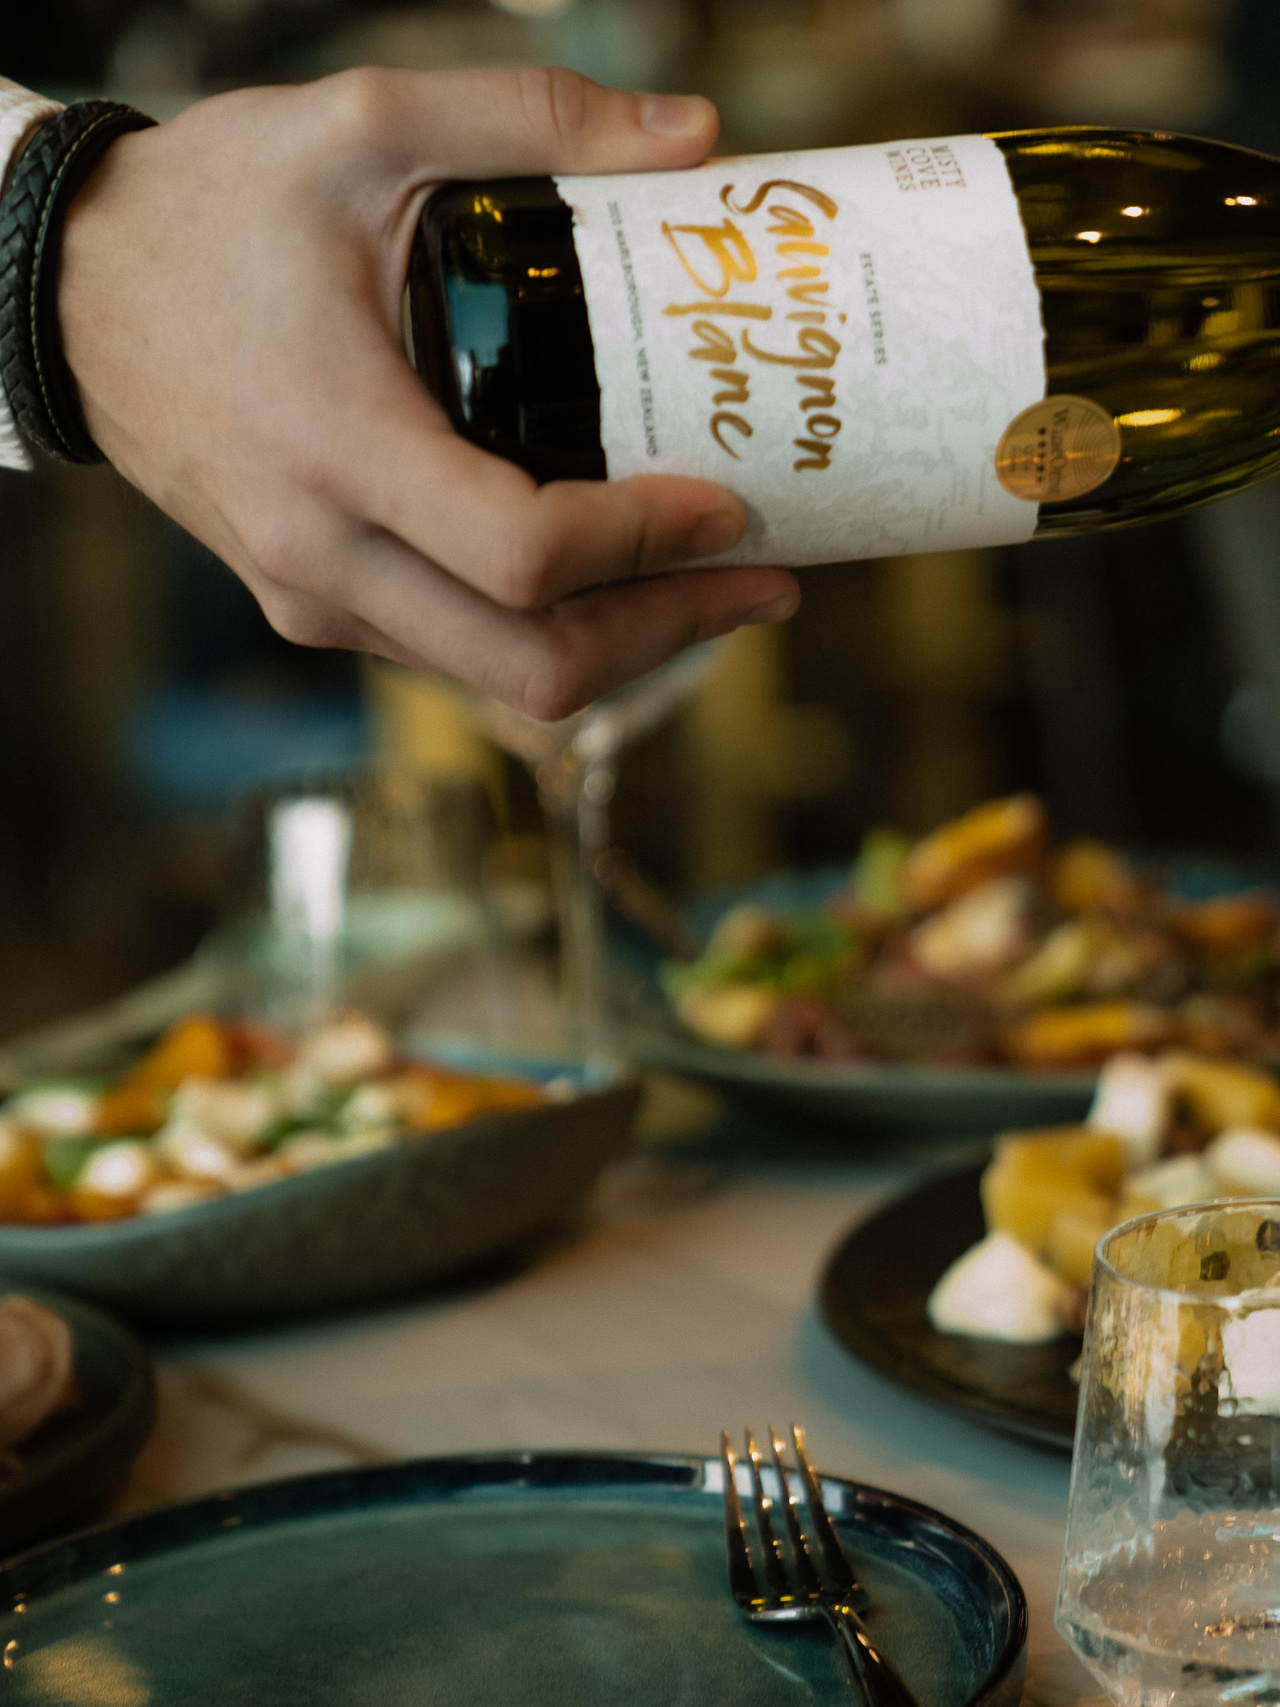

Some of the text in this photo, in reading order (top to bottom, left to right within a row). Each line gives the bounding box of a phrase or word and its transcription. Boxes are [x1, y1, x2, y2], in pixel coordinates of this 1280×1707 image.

[885, 149, 917, 192] WINES
[906, 147, 942, 191] COVE
[930, 144, 967, 188] MISTY
[720, 179, 846, 472] Sauvignon
[860, 253, 887, 365] ESTATE SERIES
[637, 347, 650, 381] NEW
[660, 217, 773, 461] Blanc
[641, 388, 658, 457] ZEALAND
